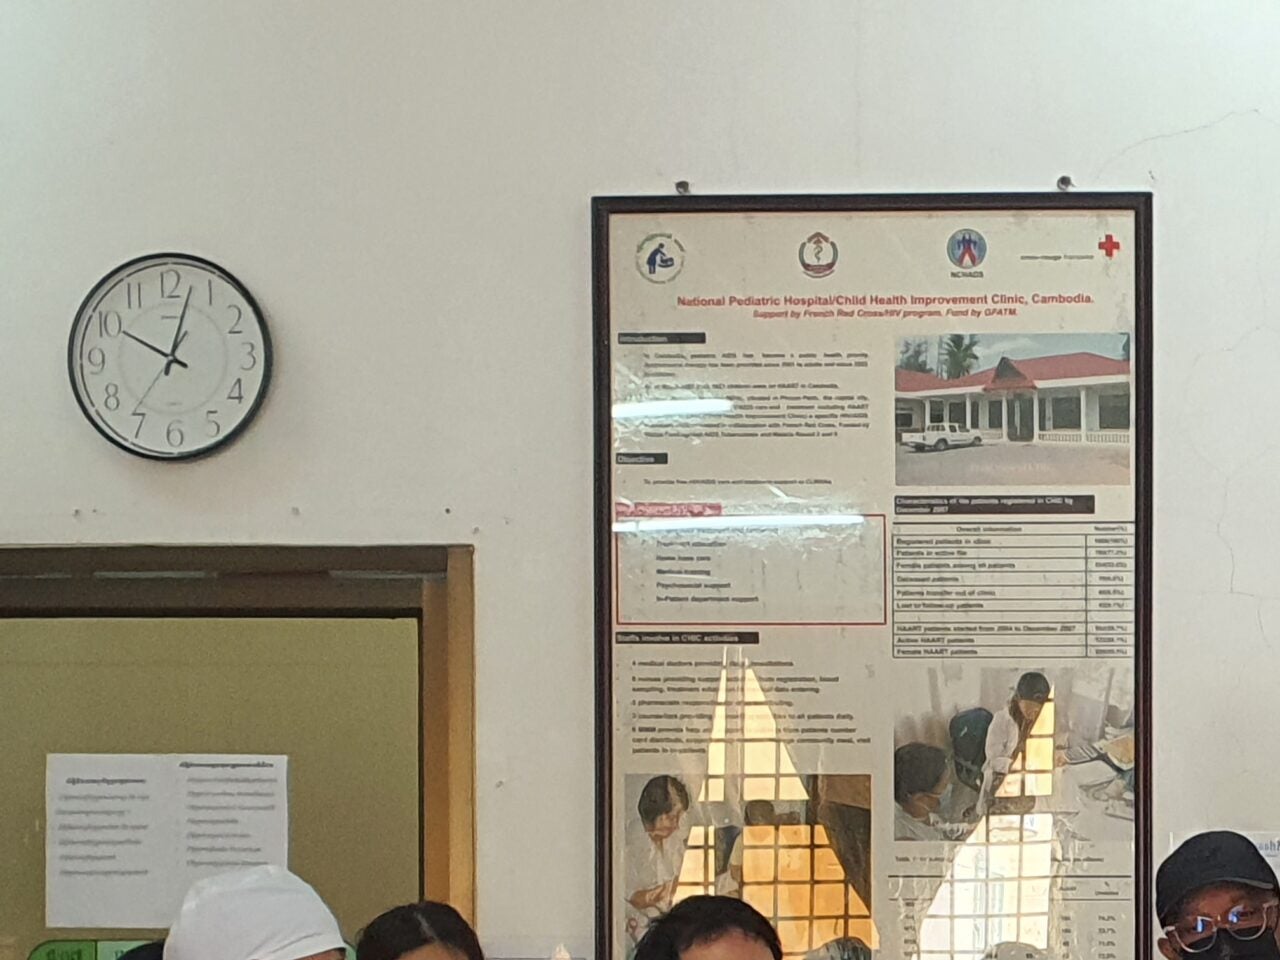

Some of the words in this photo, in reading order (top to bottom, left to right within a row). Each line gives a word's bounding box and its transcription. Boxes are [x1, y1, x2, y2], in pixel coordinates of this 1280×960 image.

[127, 282, 142, 310] 11
[160, 269, 181, 299] 12
[677, 296, 725, 306] National
[729, 296, 780, 306] Pediatric
[784, 295, 866, 307] Hospital/Child
[870, 295, 907, 305] Health
[910, 294, 988, 306] Improvement
[991, 294, 1028, 306] Clinic,
[1032, 294, 1094, 304] Cambodia.
[753, 310, 788, 319] Support
[790, 310, 800, 319] by
[803, 309, 835, 318] French
[837, 309, 854, 318] Red
[946, 308, 969, 316] Fund
[970, 308, 982, 318] by
[98, 310, 122, 338] 10
[226, 304, 243, 334] 2
[88, 347, 106, 375] 9
[240, 342, 256, 371] 3
[104, 382, 120, 412] 8
[226, 378, 244, 404] 4
[132, 412, 146, 439] 7
[166, 420, 184, 448] 6
[206, 410, 220, 438] 5
